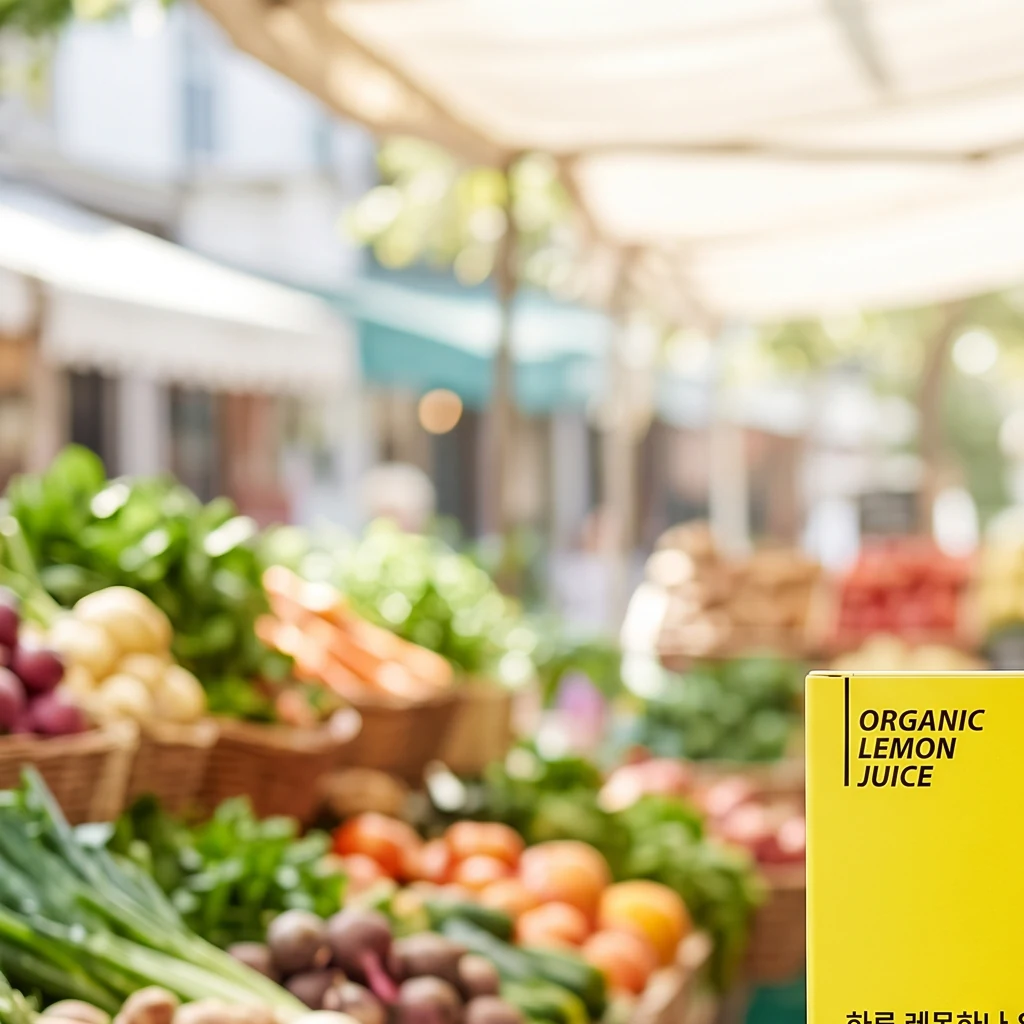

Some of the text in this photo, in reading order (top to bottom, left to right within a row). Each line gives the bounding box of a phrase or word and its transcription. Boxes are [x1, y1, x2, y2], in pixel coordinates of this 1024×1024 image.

[859, 709, 985, 731] ORGANIC
[858, 737, 957, 759] LEMON
[857, 765, 934, 787] JUICE
